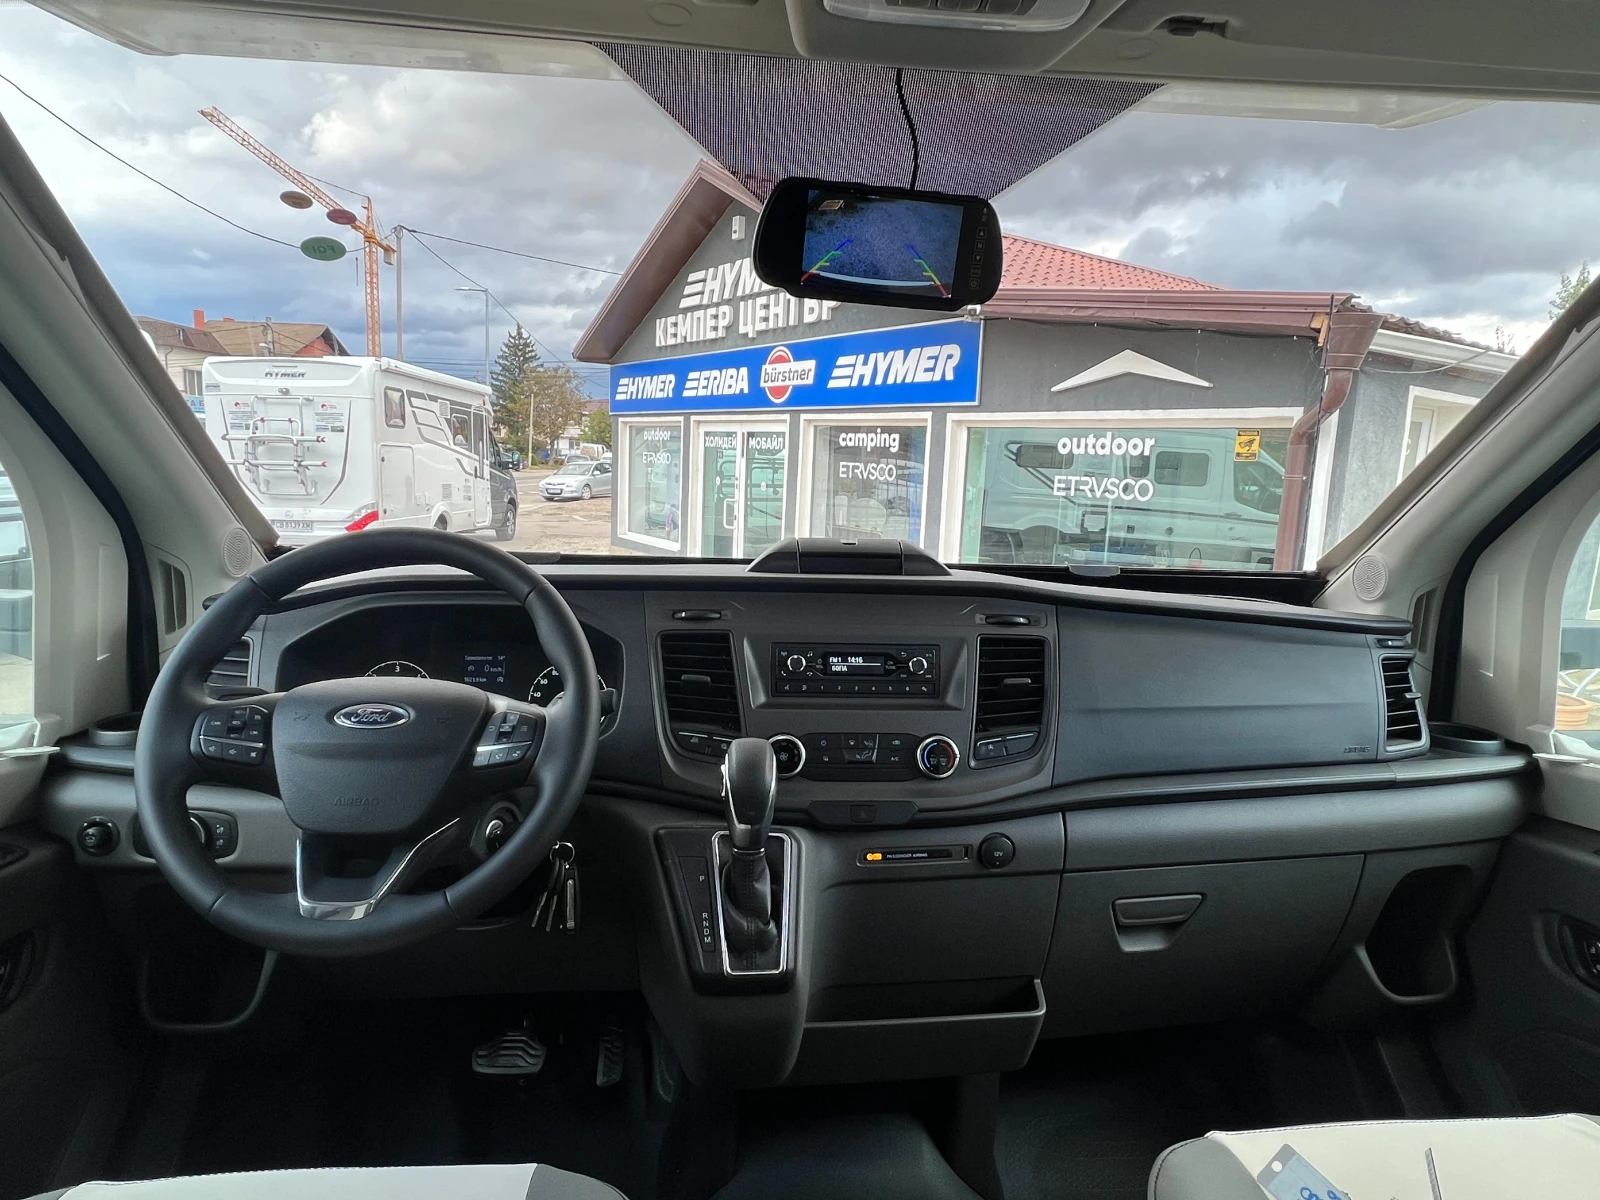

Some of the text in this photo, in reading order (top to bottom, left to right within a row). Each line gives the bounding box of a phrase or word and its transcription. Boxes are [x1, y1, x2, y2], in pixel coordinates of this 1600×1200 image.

[702, 257, 778, 305] HYM
[655, 305, 733, 347] КЕМПЕР
[763, 366, 812, 384] bürstner
[853, 343, 961, 387] HYMER
[626, 374, 676, 399] HYMER
[697, 366, 749, 396] ERIBA
[643, 427, 671, 440] outdoor
[704, 434, 784, 450] ХОЛИДЕЙ МОБАЙЛ
[839, 428, 900, 452] camping
[1057, 431, 1156, 457] outdoor
[351, 708, 391, 722] Ford
